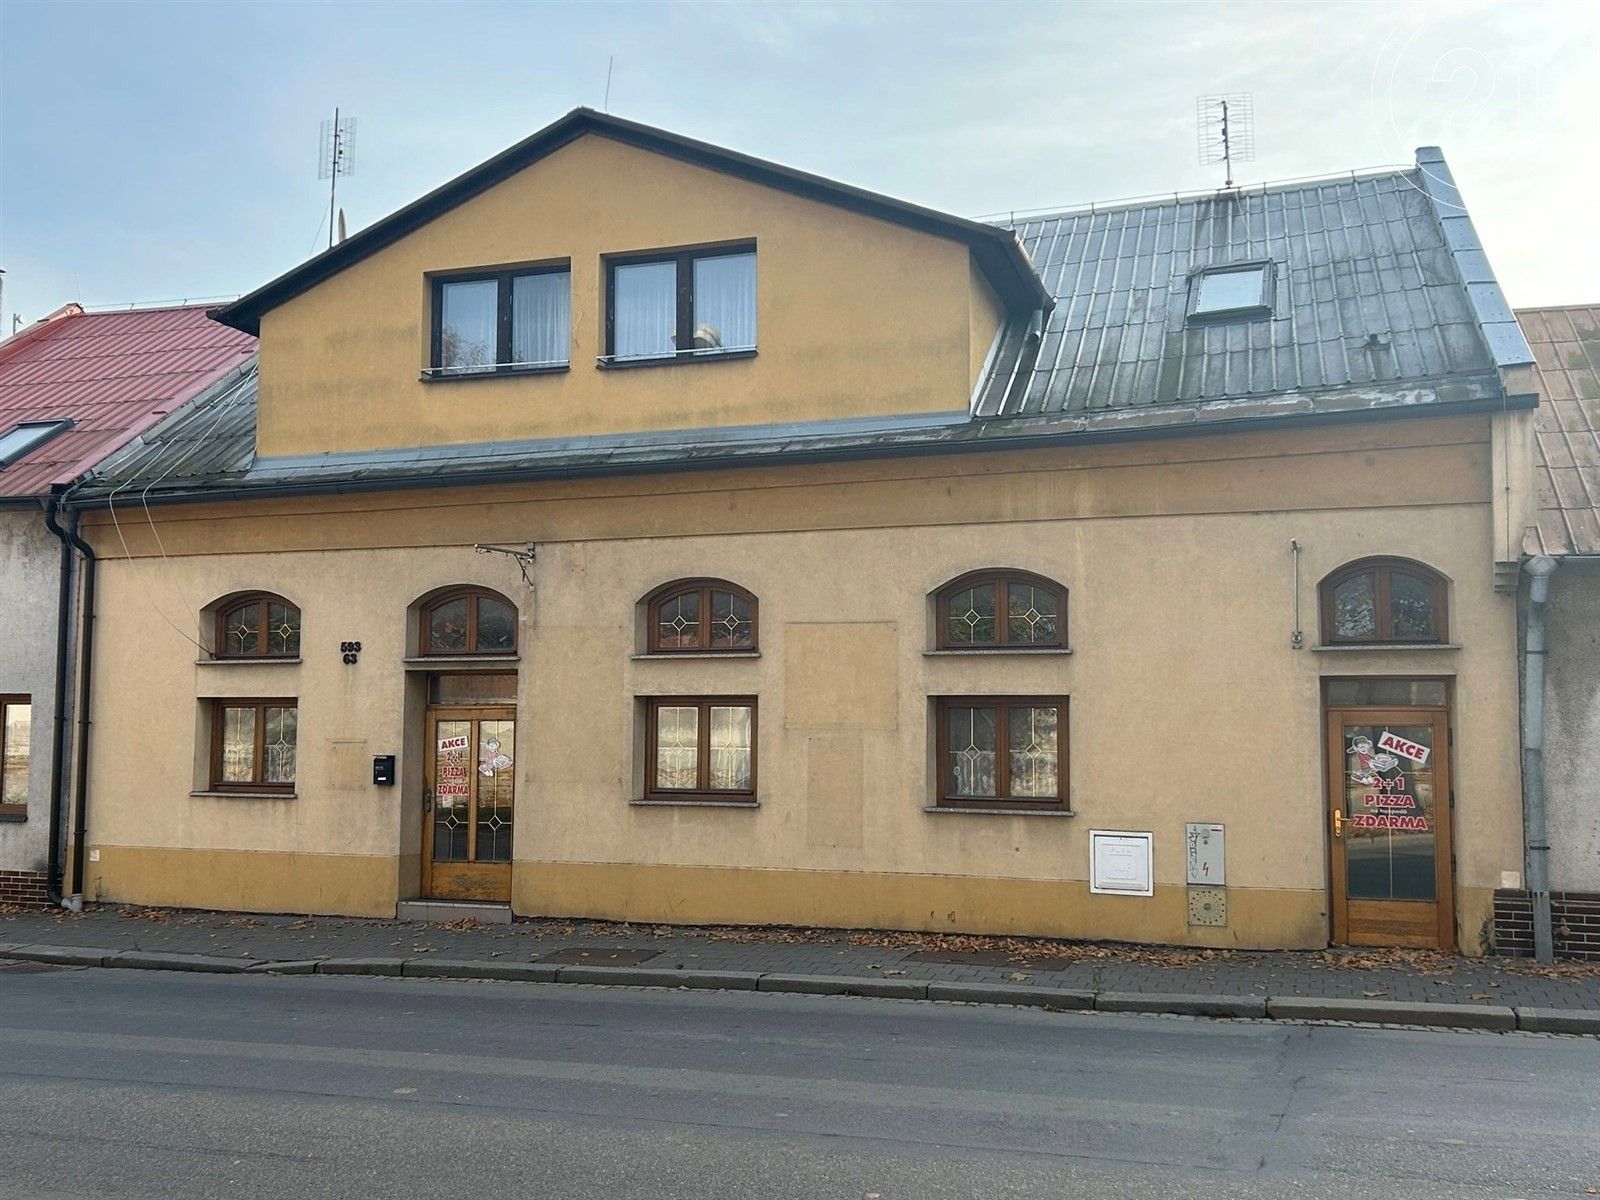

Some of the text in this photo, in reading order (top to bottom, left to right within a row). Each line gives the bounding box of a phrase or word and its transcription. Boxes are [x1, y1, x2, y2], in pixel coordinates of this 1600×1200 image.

[340, 641, 362, 653] 593
[342, 653, 359, 666] 63
[441, 737, 466, 749] AKCE
[1382, 735, 1425, 760] AKCE
[442, 766, 465, 777] PIZZA
[437, 784, 469, 796] ZDARMA
[1364, 794, 1415, 808] PIZZA
[1353, 814, 1428, 830] ZDARMA
